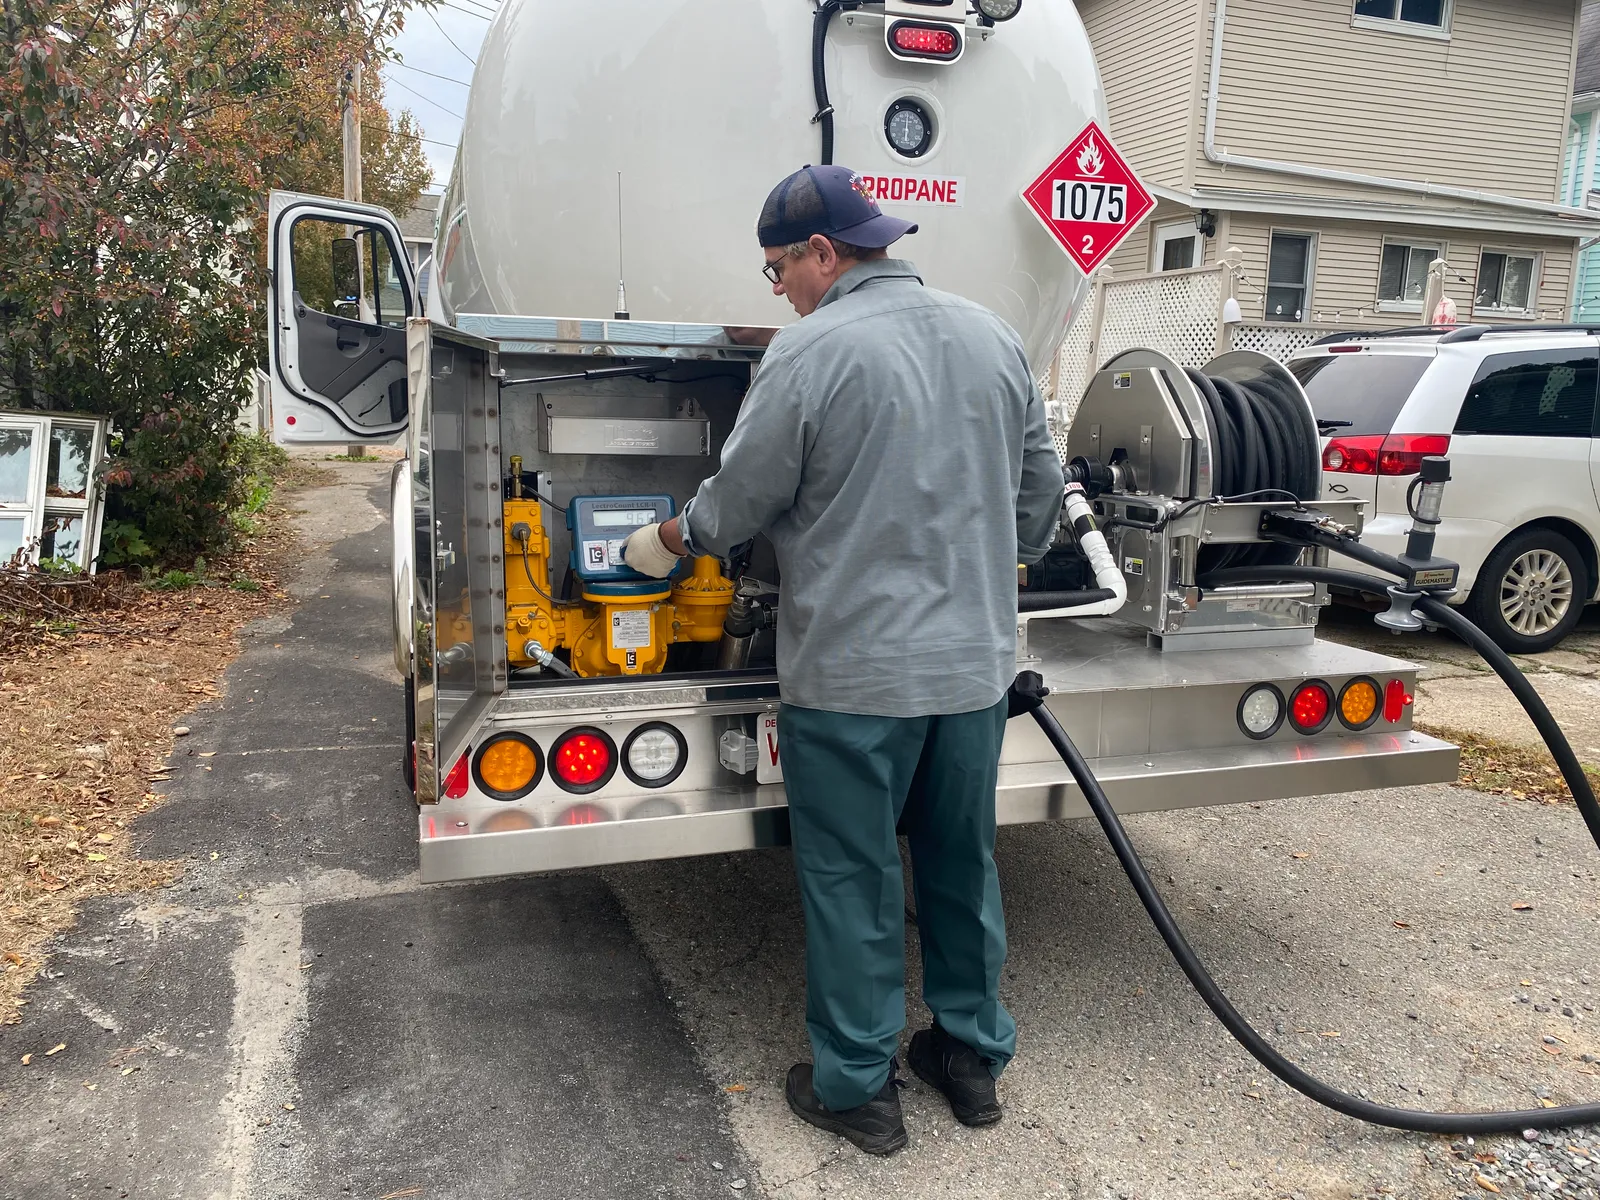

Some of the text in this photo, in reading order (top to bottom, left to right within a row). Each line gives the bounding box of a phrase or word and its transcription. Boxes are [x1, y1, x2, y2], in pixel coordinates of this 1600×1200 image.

[862, 176, 958, 203] PROPANE
[1055, 181, 1124, 222] 1075
[1081, 234, 1094, 254] 2
[1089, 340, 1094, 354] 8
[591, 502, 635, 510] LectroCount
[765, 719, 776, 728] DE
[766, 732, 779, 767] V
